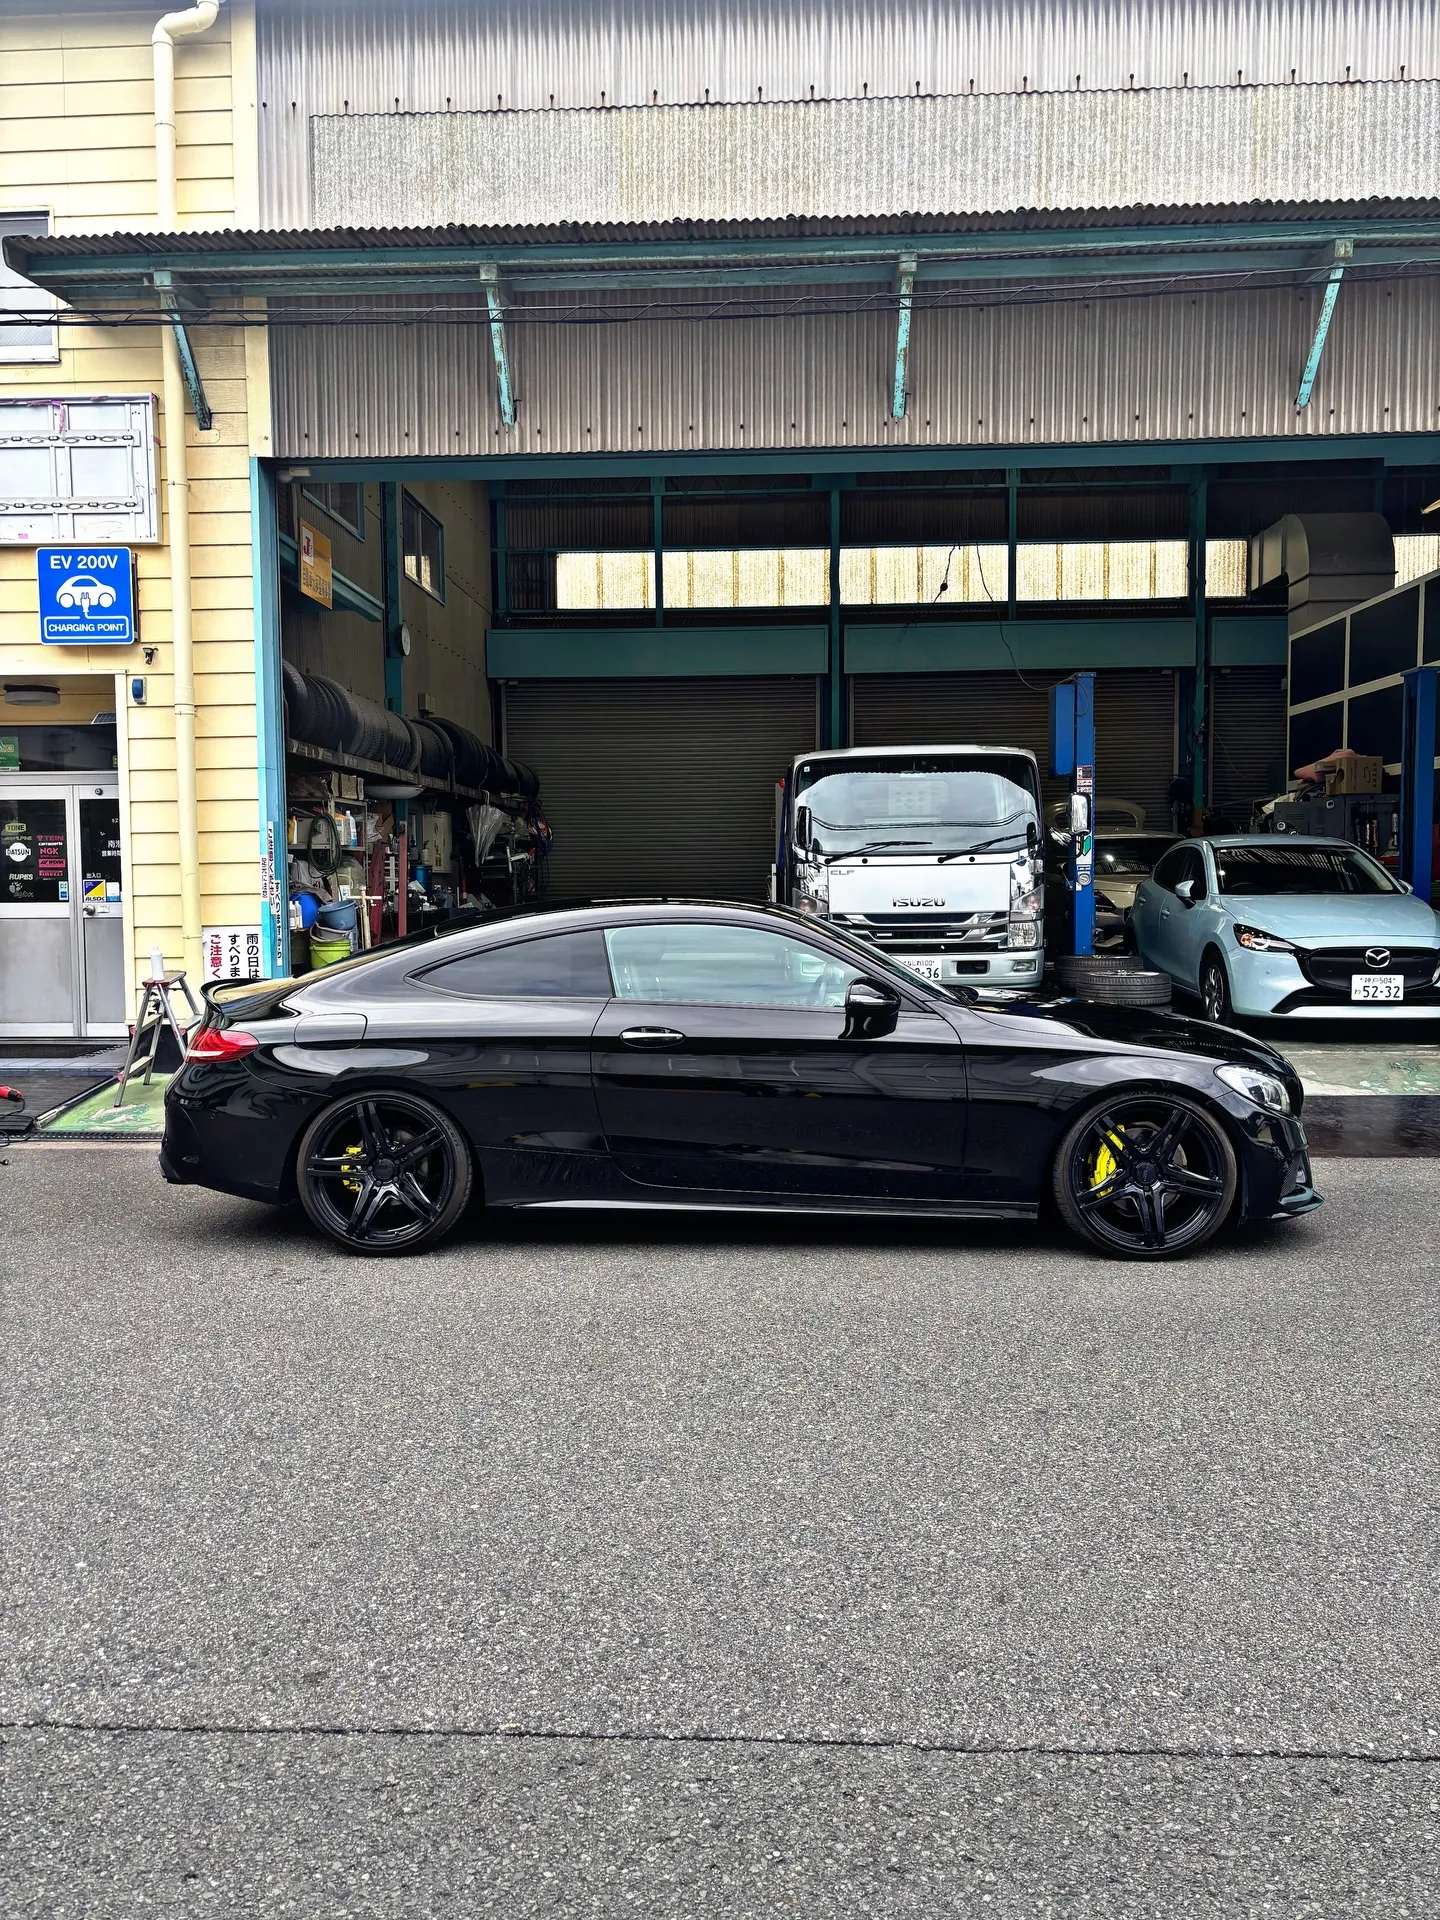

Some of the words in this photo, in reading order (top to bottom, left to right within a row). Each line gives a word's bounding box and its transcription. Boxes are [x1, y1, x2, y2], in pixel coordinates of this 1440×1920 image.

[50, 555, 72, 569] EV
[77, 555, 118, 569] 200V
[48, 624, 95, 632] CHARGING
[97, 623, 124, 632] POINT
[893, 898, 945, 907] ISUZU
[210, 934, 222, 978] ご注意く
[228, 934, 240, 977] すべりま
[246, 933, 260, 979] 雨の日は
[1363, 986, 1400, 998] 52-32
